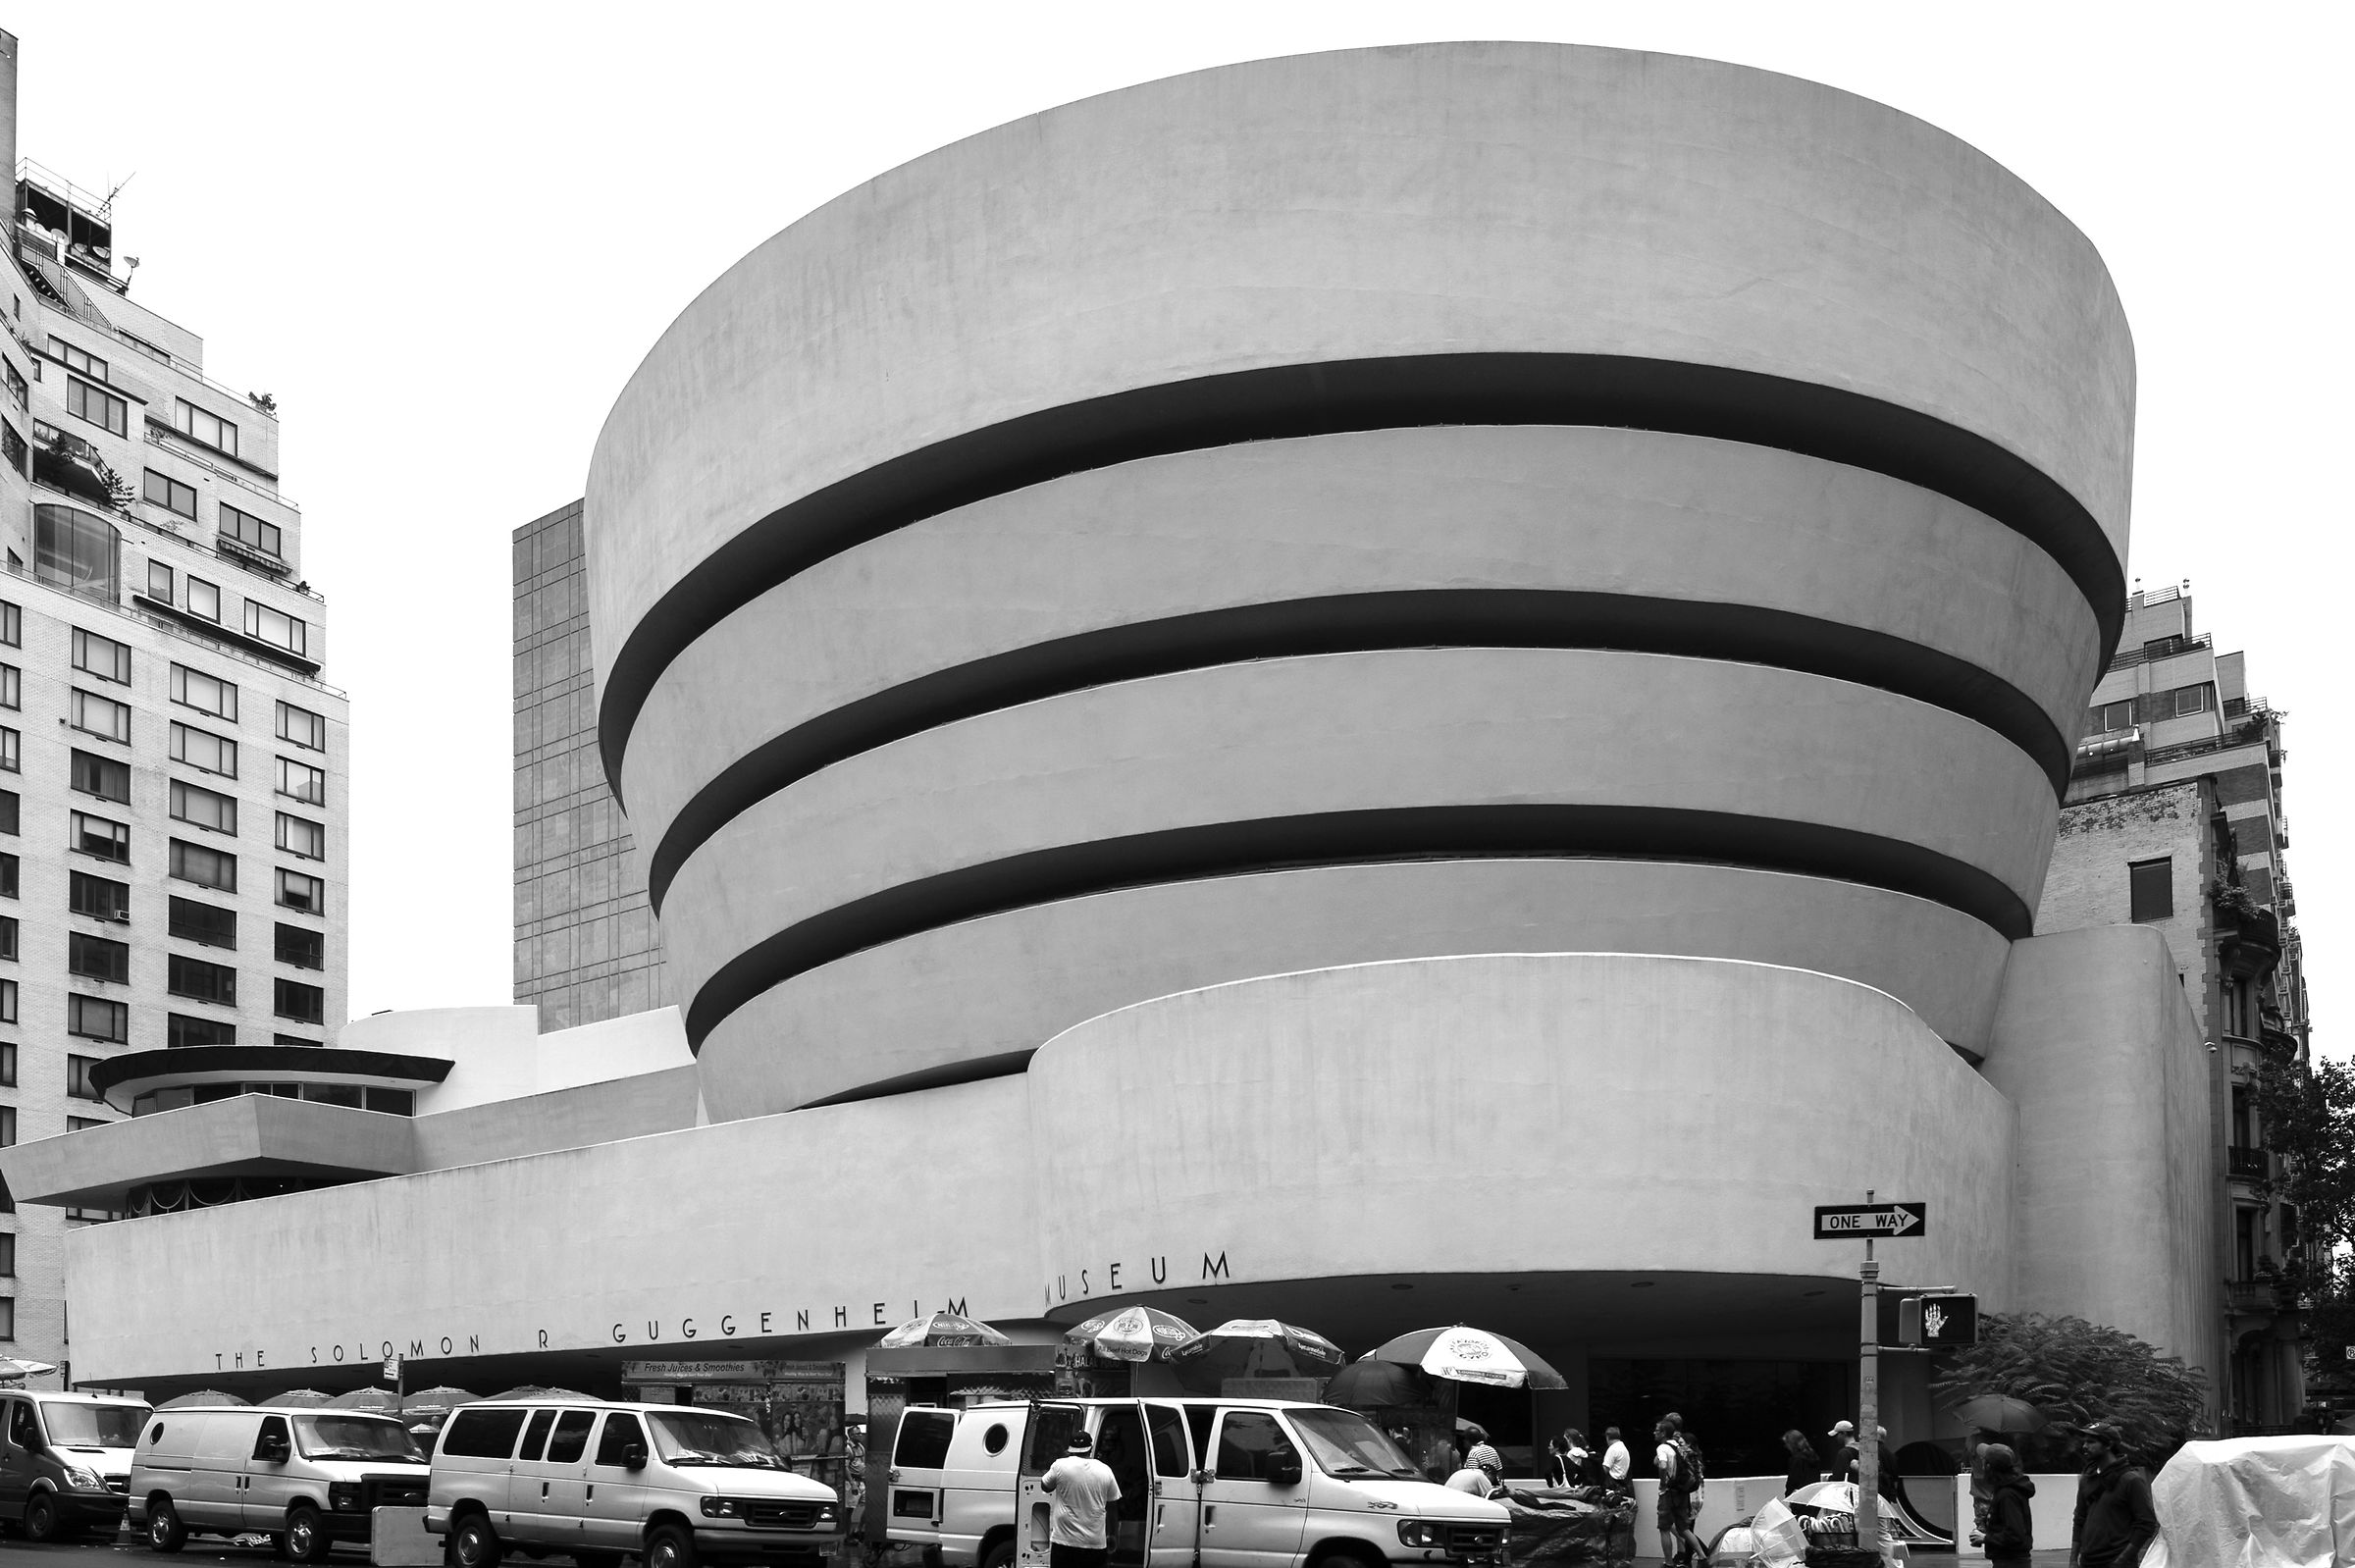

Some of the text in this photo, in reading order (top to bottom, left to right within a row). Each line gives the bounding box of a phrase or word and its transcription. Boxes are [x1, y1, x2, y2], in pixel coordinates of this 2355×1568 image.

[1829, 1213, 1909, 1228] ONE WAY
[215, 1350, 265, 1371] THE
[311, 1334, 480, 1364] SOLOMON
[538, 1329, 549, 1349] R
[612, 1296, 969, 1343] GUGGENHEIM
[1044, 1250, 1230, 1308] MUSEUM
[644, 1362, 745, 1373] Fresh Juices & Smoothies
